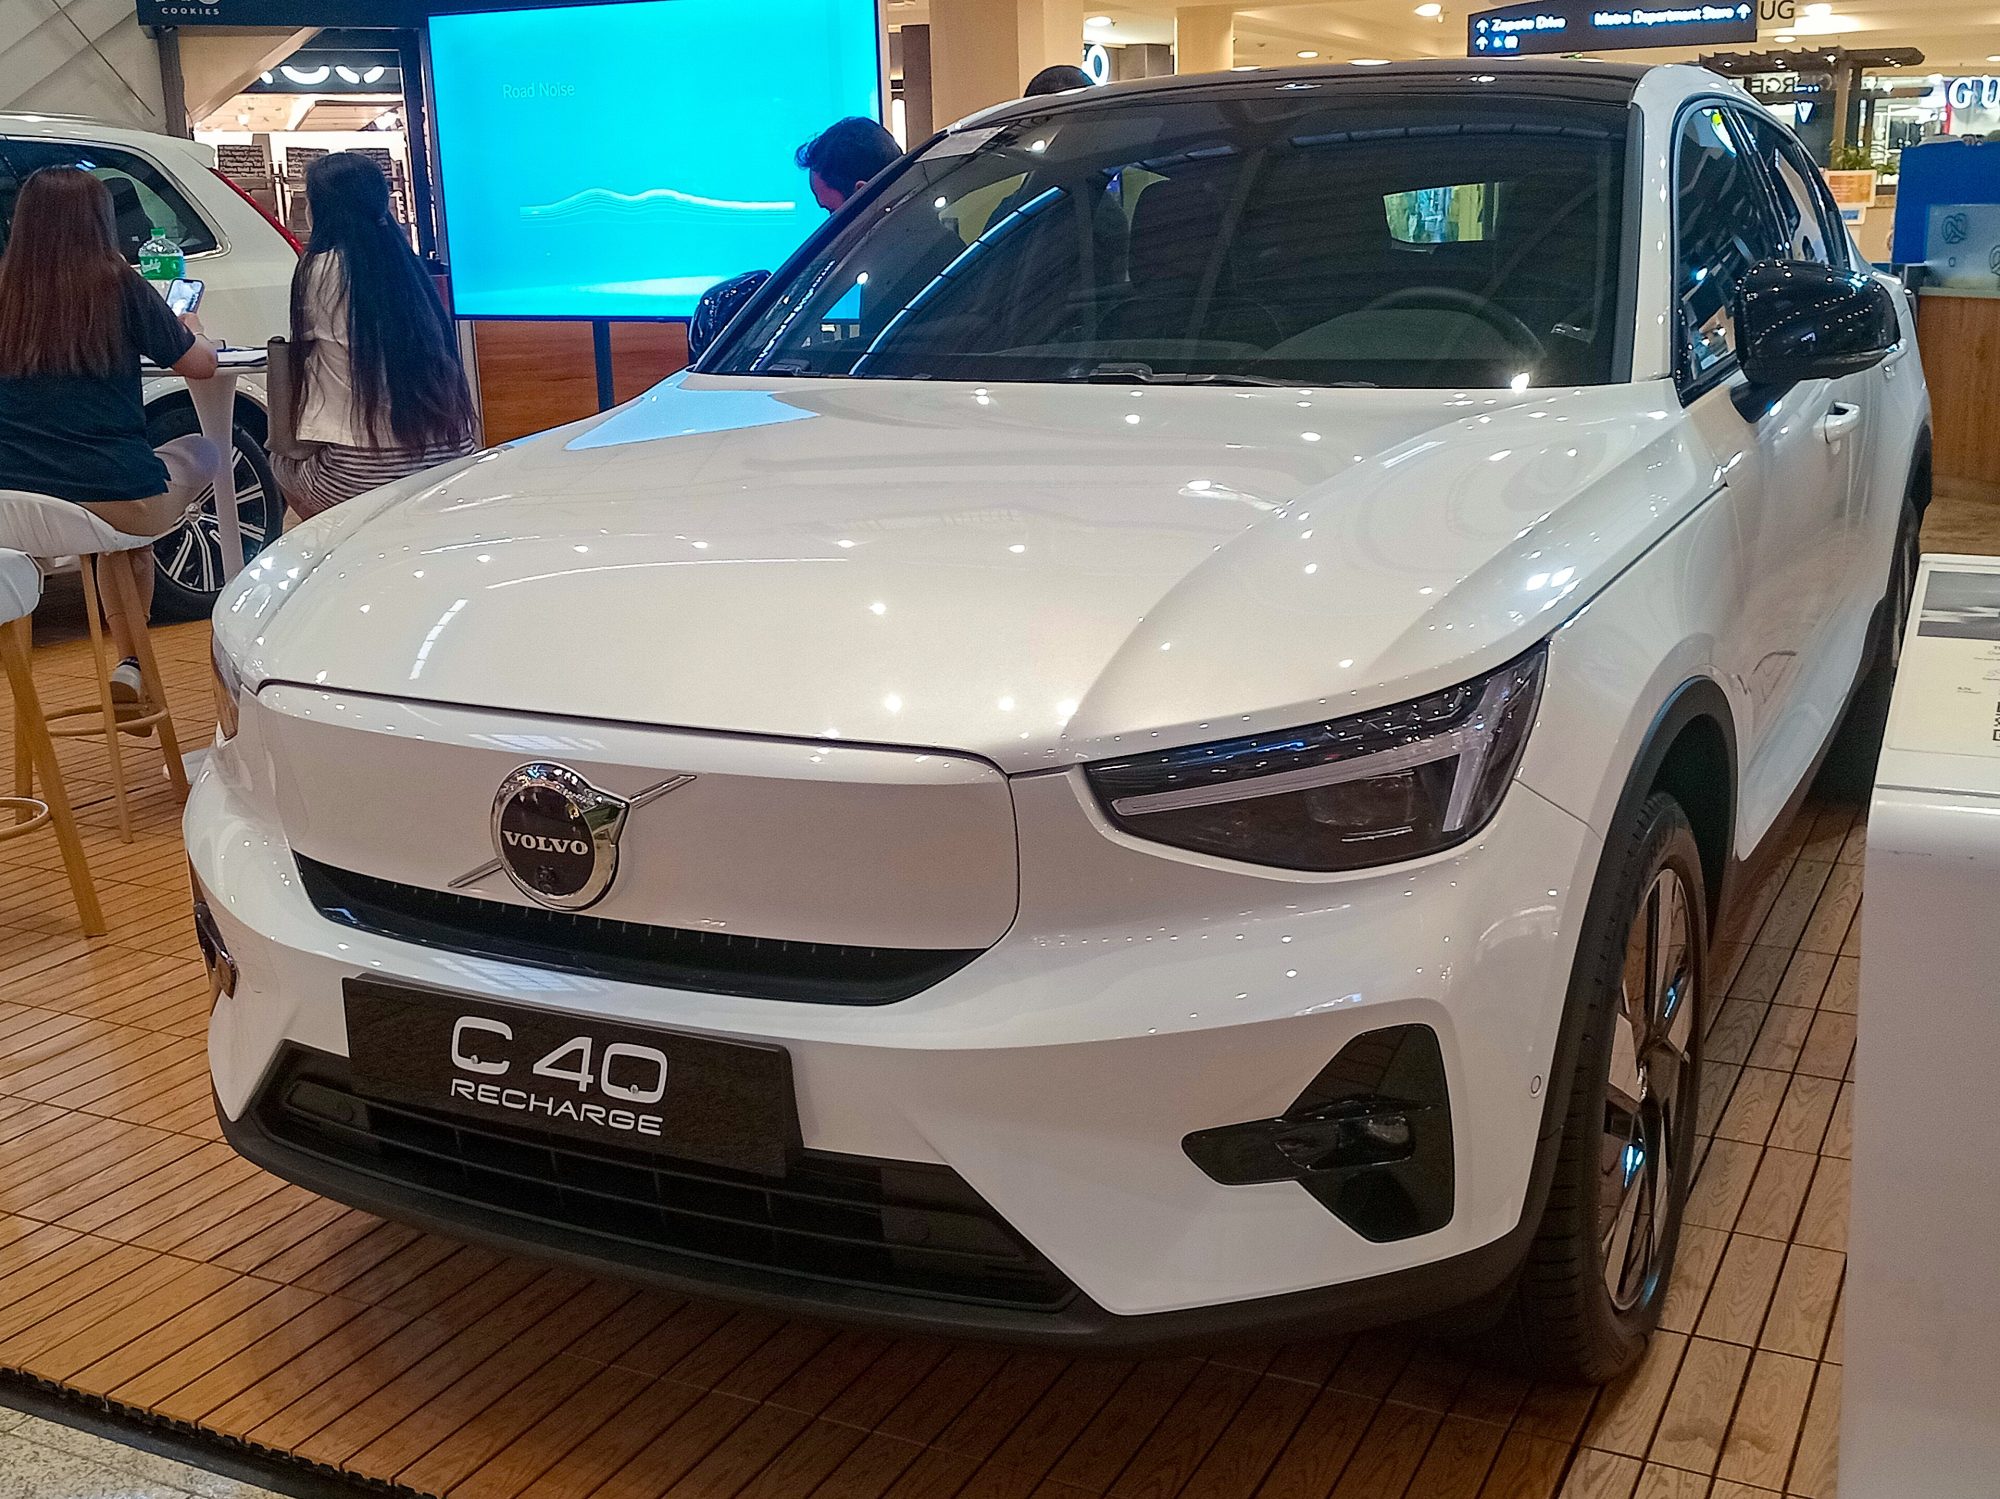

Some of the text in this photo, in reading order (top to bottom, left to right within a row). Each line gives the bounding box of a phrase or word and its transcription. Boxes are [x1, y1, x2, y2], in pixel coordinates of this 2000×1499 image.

[161, 7, 220, 15] COOKIES
[1760, 0, 1795, 20] UG
[503, 82, 576, 99] Road Noise
[503, 830, 588, 855] VOLVO
[450, 1078, 664, 1136] RECHARGE
